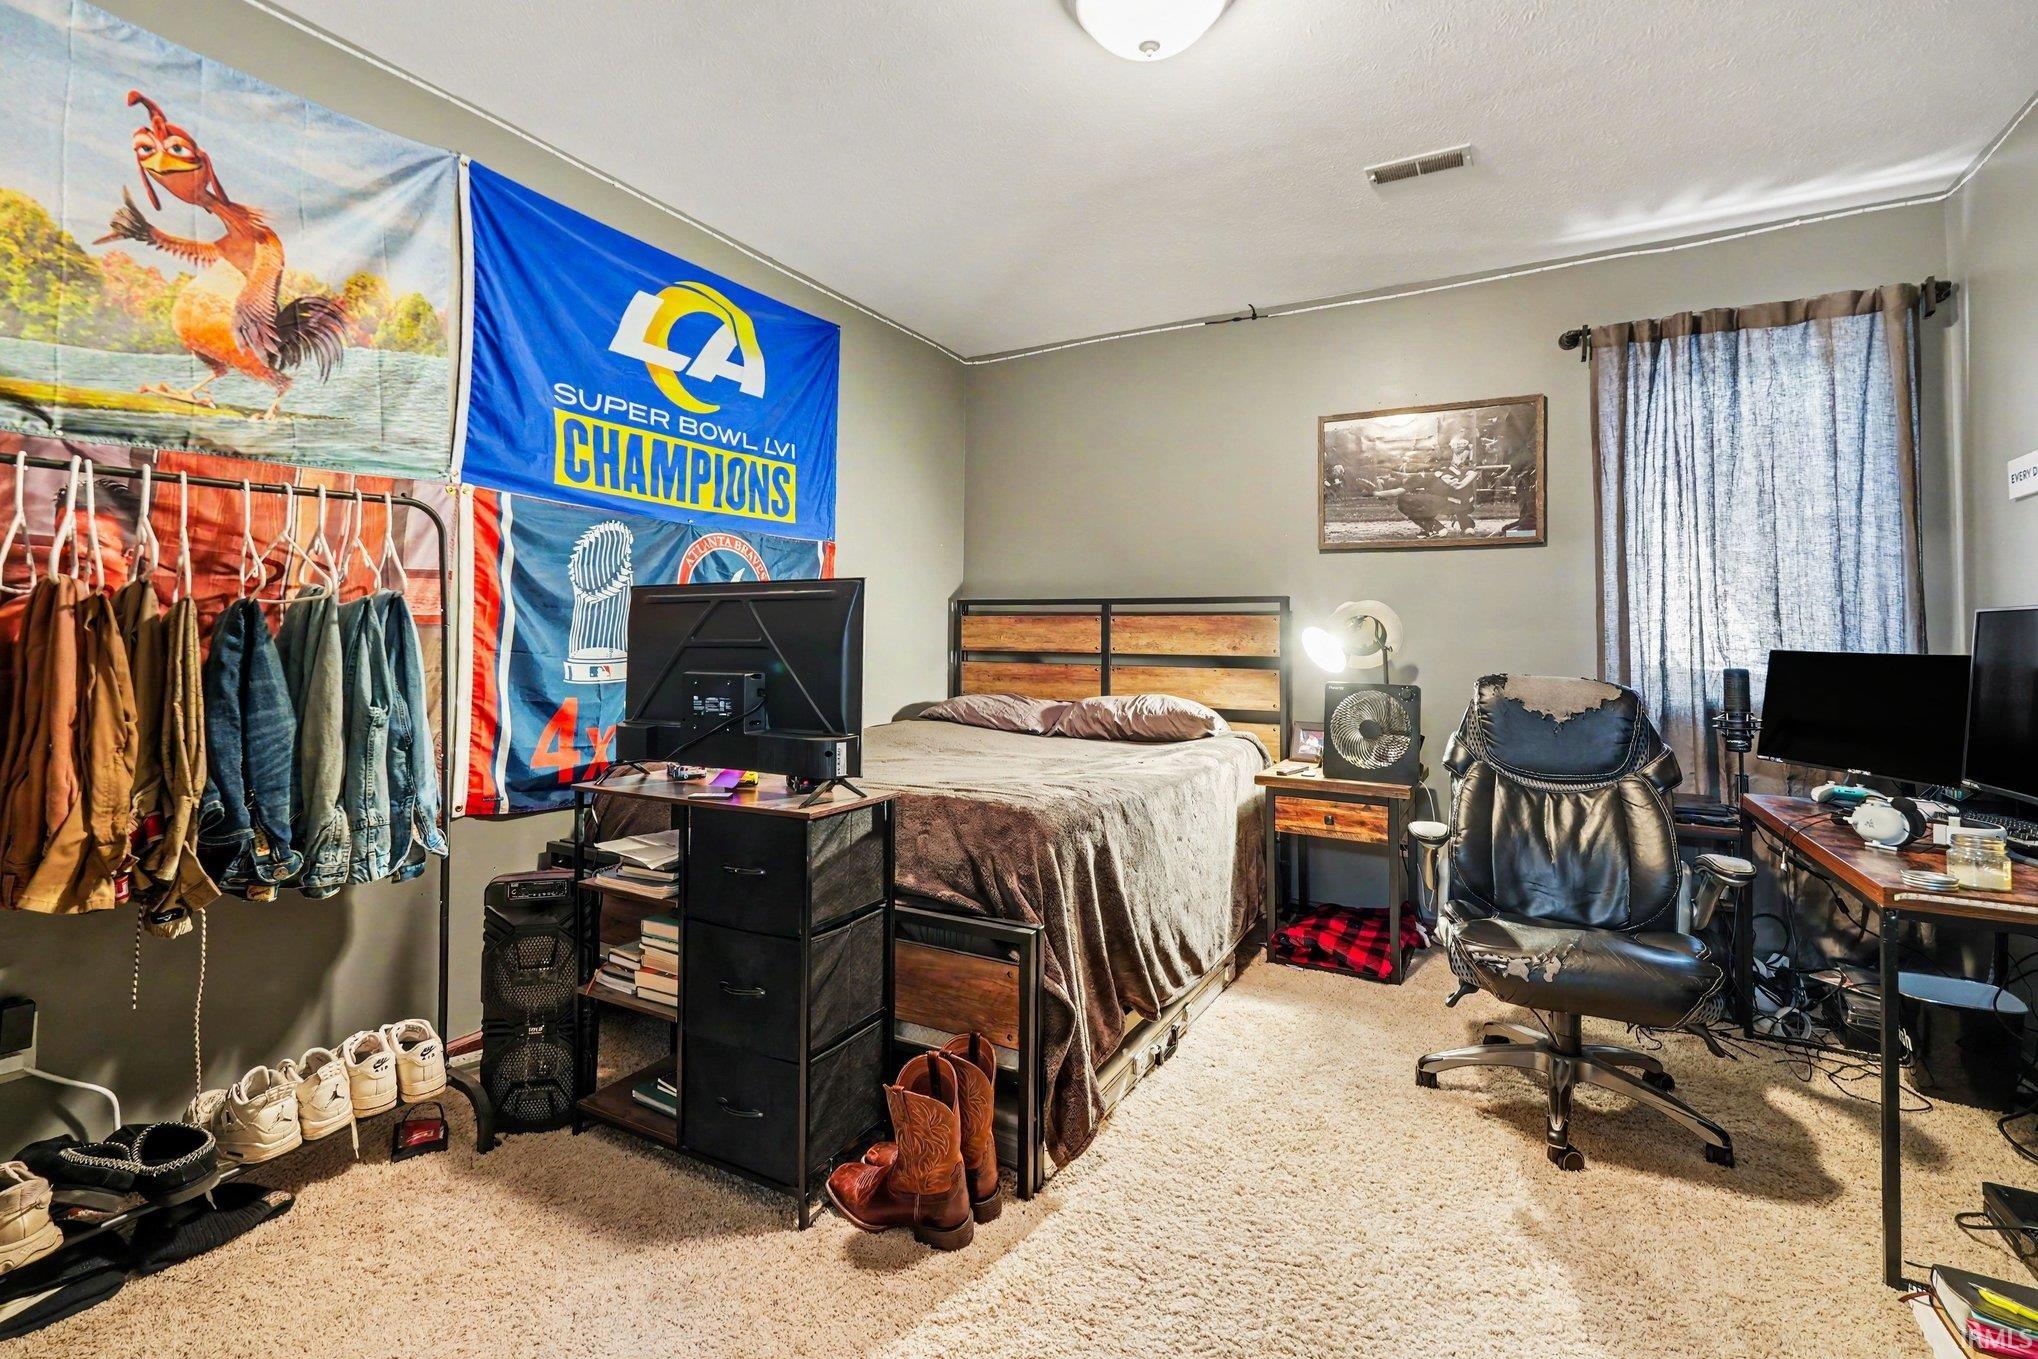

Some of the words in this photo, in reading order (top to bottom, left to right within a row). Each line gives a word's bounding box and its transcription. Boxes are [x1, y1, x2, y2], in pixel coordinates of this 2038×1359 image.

[608, 290, 766, 399] LA
[554, 383, 670, 430] SUPER
[678, 415, 758, 450] BOWL
[764, 436, 796, 460] LVI
[563, 418, 794, 516] CHAMPIONS
[2010, 467, 2032, 484] EVERY
